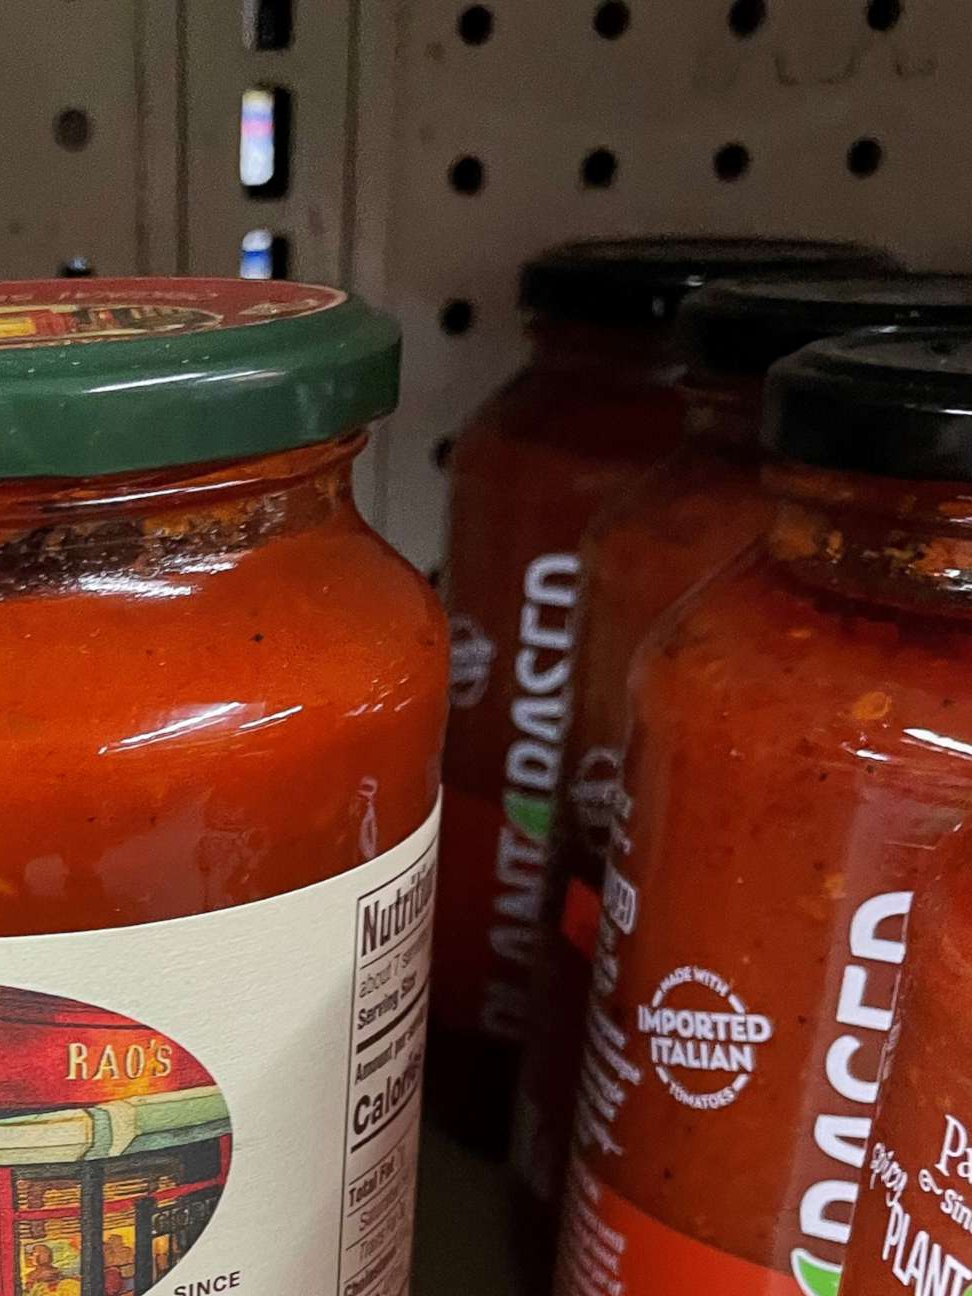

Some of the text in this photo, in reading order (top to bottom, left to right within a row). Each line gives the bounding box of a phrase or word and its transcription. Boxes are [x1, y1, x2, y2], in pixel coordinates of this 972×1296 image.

[660, 966, 730, 997] MADE WITH
[638, 1004, 772, 1043] IMPORTED
[65, 1037, 174, 1082] RAO'S
[651, 1036, 755, 1072] ITALIAN
[669, 1080, 736, 1110] TOMATOES
